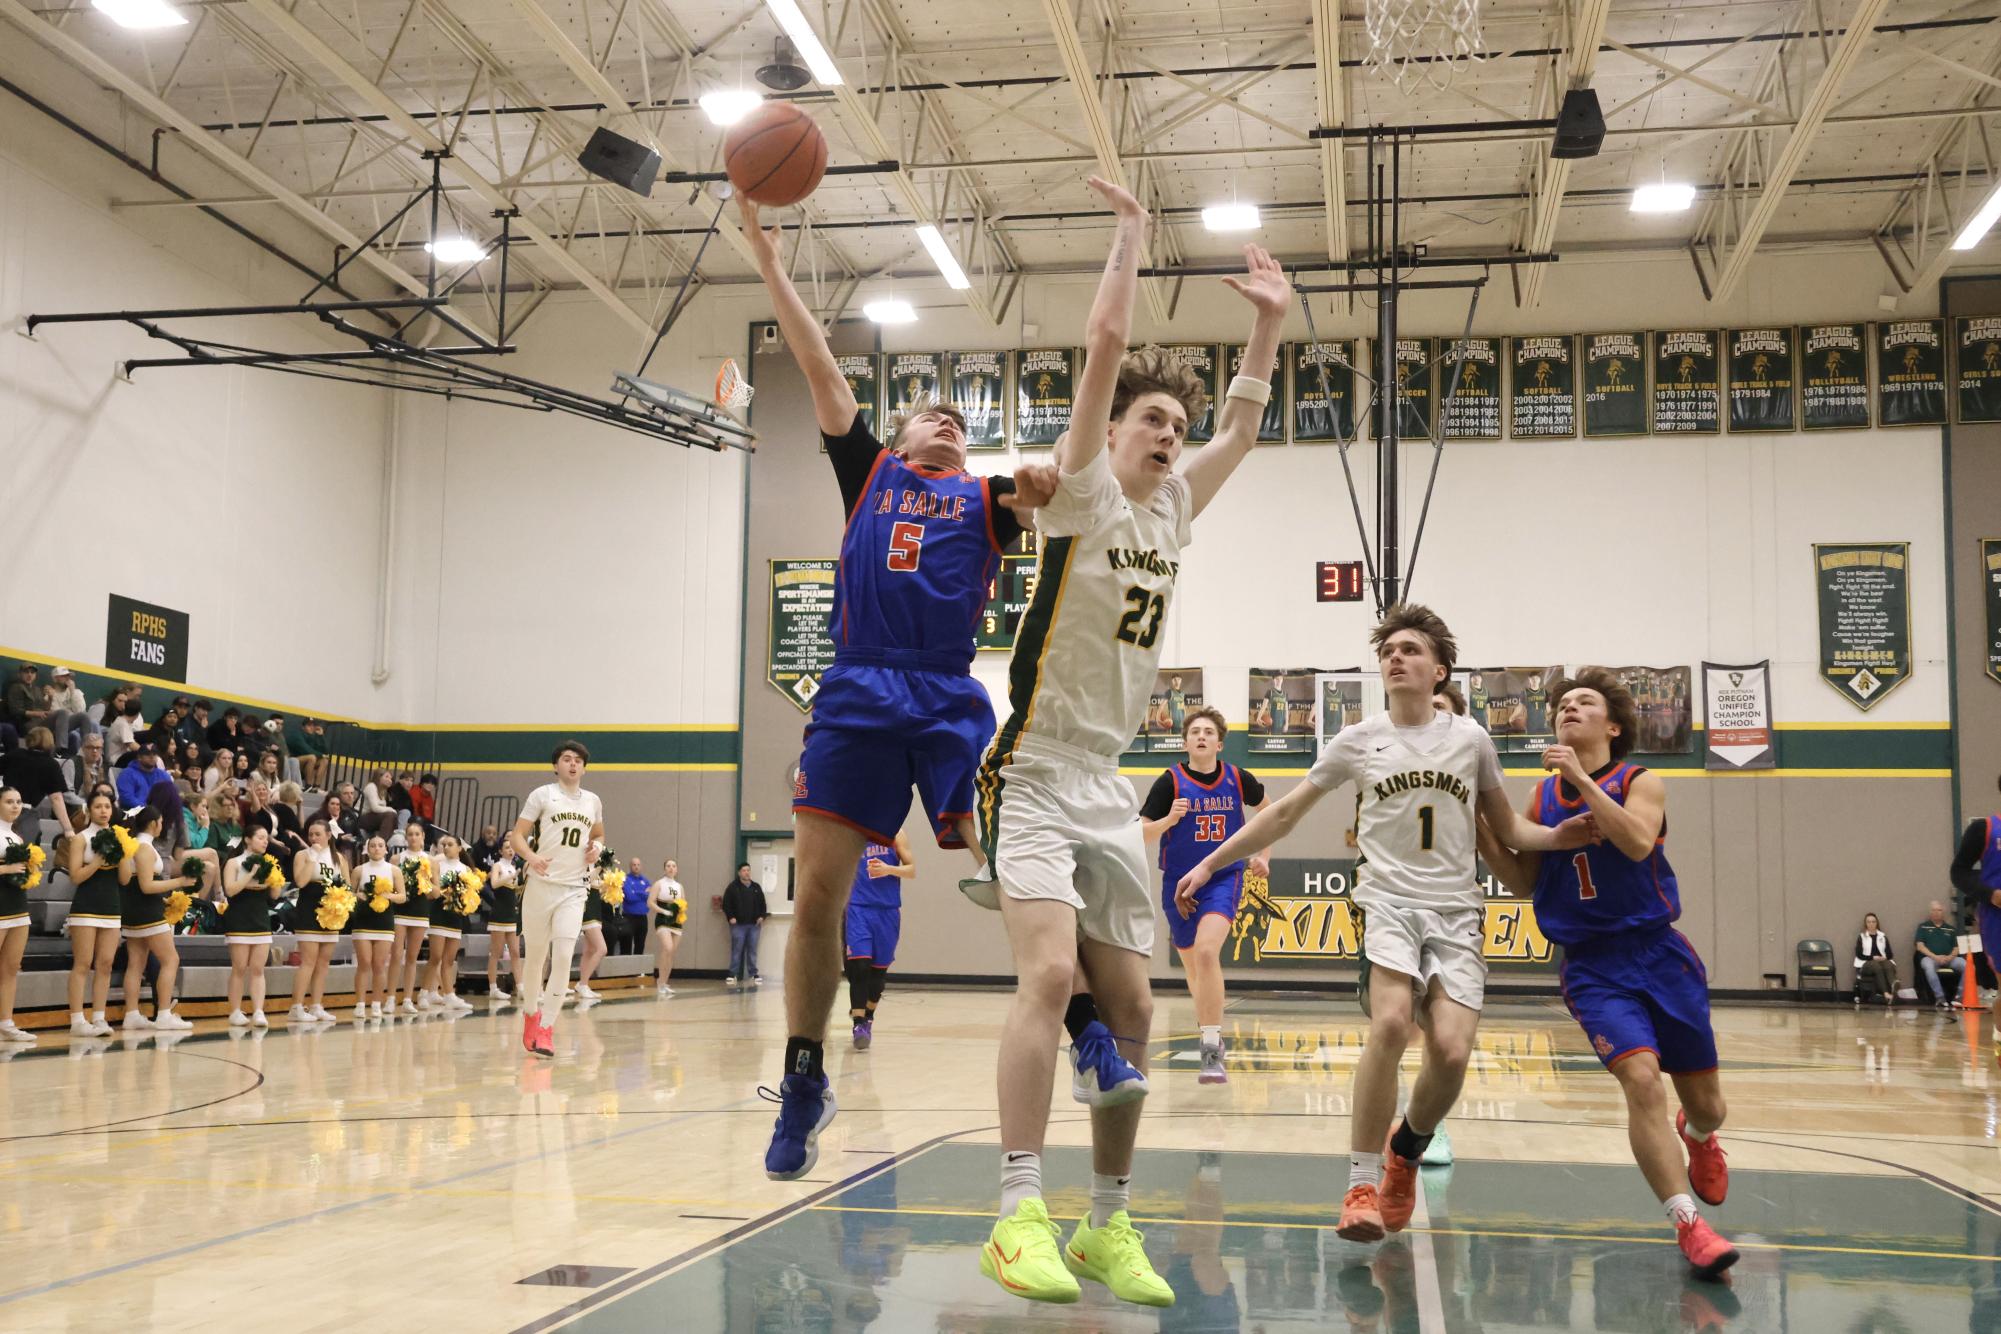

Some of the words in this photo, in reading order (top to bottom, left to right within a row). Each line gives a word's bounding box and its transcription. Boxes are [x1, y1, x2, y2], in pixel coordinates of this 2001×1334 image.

[1812, 327, 1853, 338] LEAGUE
[1890, 322, 1932, 334] LEAGUE
[1594, 335, 1633, 346] LEAGUE
[1667, 332, 1706, 343] LEAGUE
[1740, 330, 1780, 341] LEAGUE
[1884, 332, 1938, 349] CHAMPIONS
[1523, 338, 1561, 349] LEAGUE
[1735, 340, 1786, 356] CHAMPIONS
[1807, 336, 1859, 353] CHAMPIONS
[1170, 346, 1206, 357] LEAGUE
[1589, 344, 1639, 360] CHAMPIONS
[1661, 342, 1712, 358] CHAMPIONS
[897, 355, 933, 366] LEAGUE
[960, 353, 996, 364] LEAGUE
[1026, 351, 1062, 361] LEAGUE
[1518, 348, 1567, 364] CHAMPIONS
[845, 365, 873, 379] AMPIONS
[892, 364, 937, 378] CHAMPIONS
[955, 363, 1000, 378] CHAMPIONS
[1021, 361, 1068, 376] CHAMPIONS
[1809, 376, 1859, 385] VOLLEYBALL
[1888, 373, 1936, 381] WRESTLING
[1596, 384, 1635, 393] SOFTBALL
[1960, 380, 1981, 389] 2014
[1514, 396, 1533, 404] 2000
[1554, 395, 1573, 403] 2002
[1586, 393, 1605, 402] 2016
[1656, 391, 1675, 399] 1970
[1697, 390, 1716, 398] 1975
[1677, 401, 1696, 410] 1977
[1697, 401, 1716, 409] 1991
[1697, 411, 1716, 419] 2004
[1514, 417, 1533, 425] 2007
[1676, 422, 1696, 430] 2009
[1460, 428, 1478, 436] 1997
[1480, 428, 1499, 436] 1998
[1534, 426, 1553, 434] 2014
[898, 489, 967, 522] SALLE
[887, 521, 925, 572] 5
[1016, 566, 1036, 575] PERI
[1324, 566, 1358, 595] 31
[1115, 585, 1165, 650] 23
[131, 611, 167, 639] RPHS
[987, 617, 996, 634] 3
[130, 638, 165, 666] FANS
[1718, 694, 1755, 702] OREGON
[1714, 711, 1761, 719] CHAMPION
[1720, 719, 1755, 727] SCHOOL
[1374, 770, 1470, 805] KINGSMEN
[1204, 797, 1234, 812] SALLE
[550, 812, 593, 829] KINGSMEN
[1195, 814, 1227, 842] 33
[1418, 805, 1434, 851] 1
[560, 827, 582, 848] 10
[1572, 851, 1598, 900] 1
